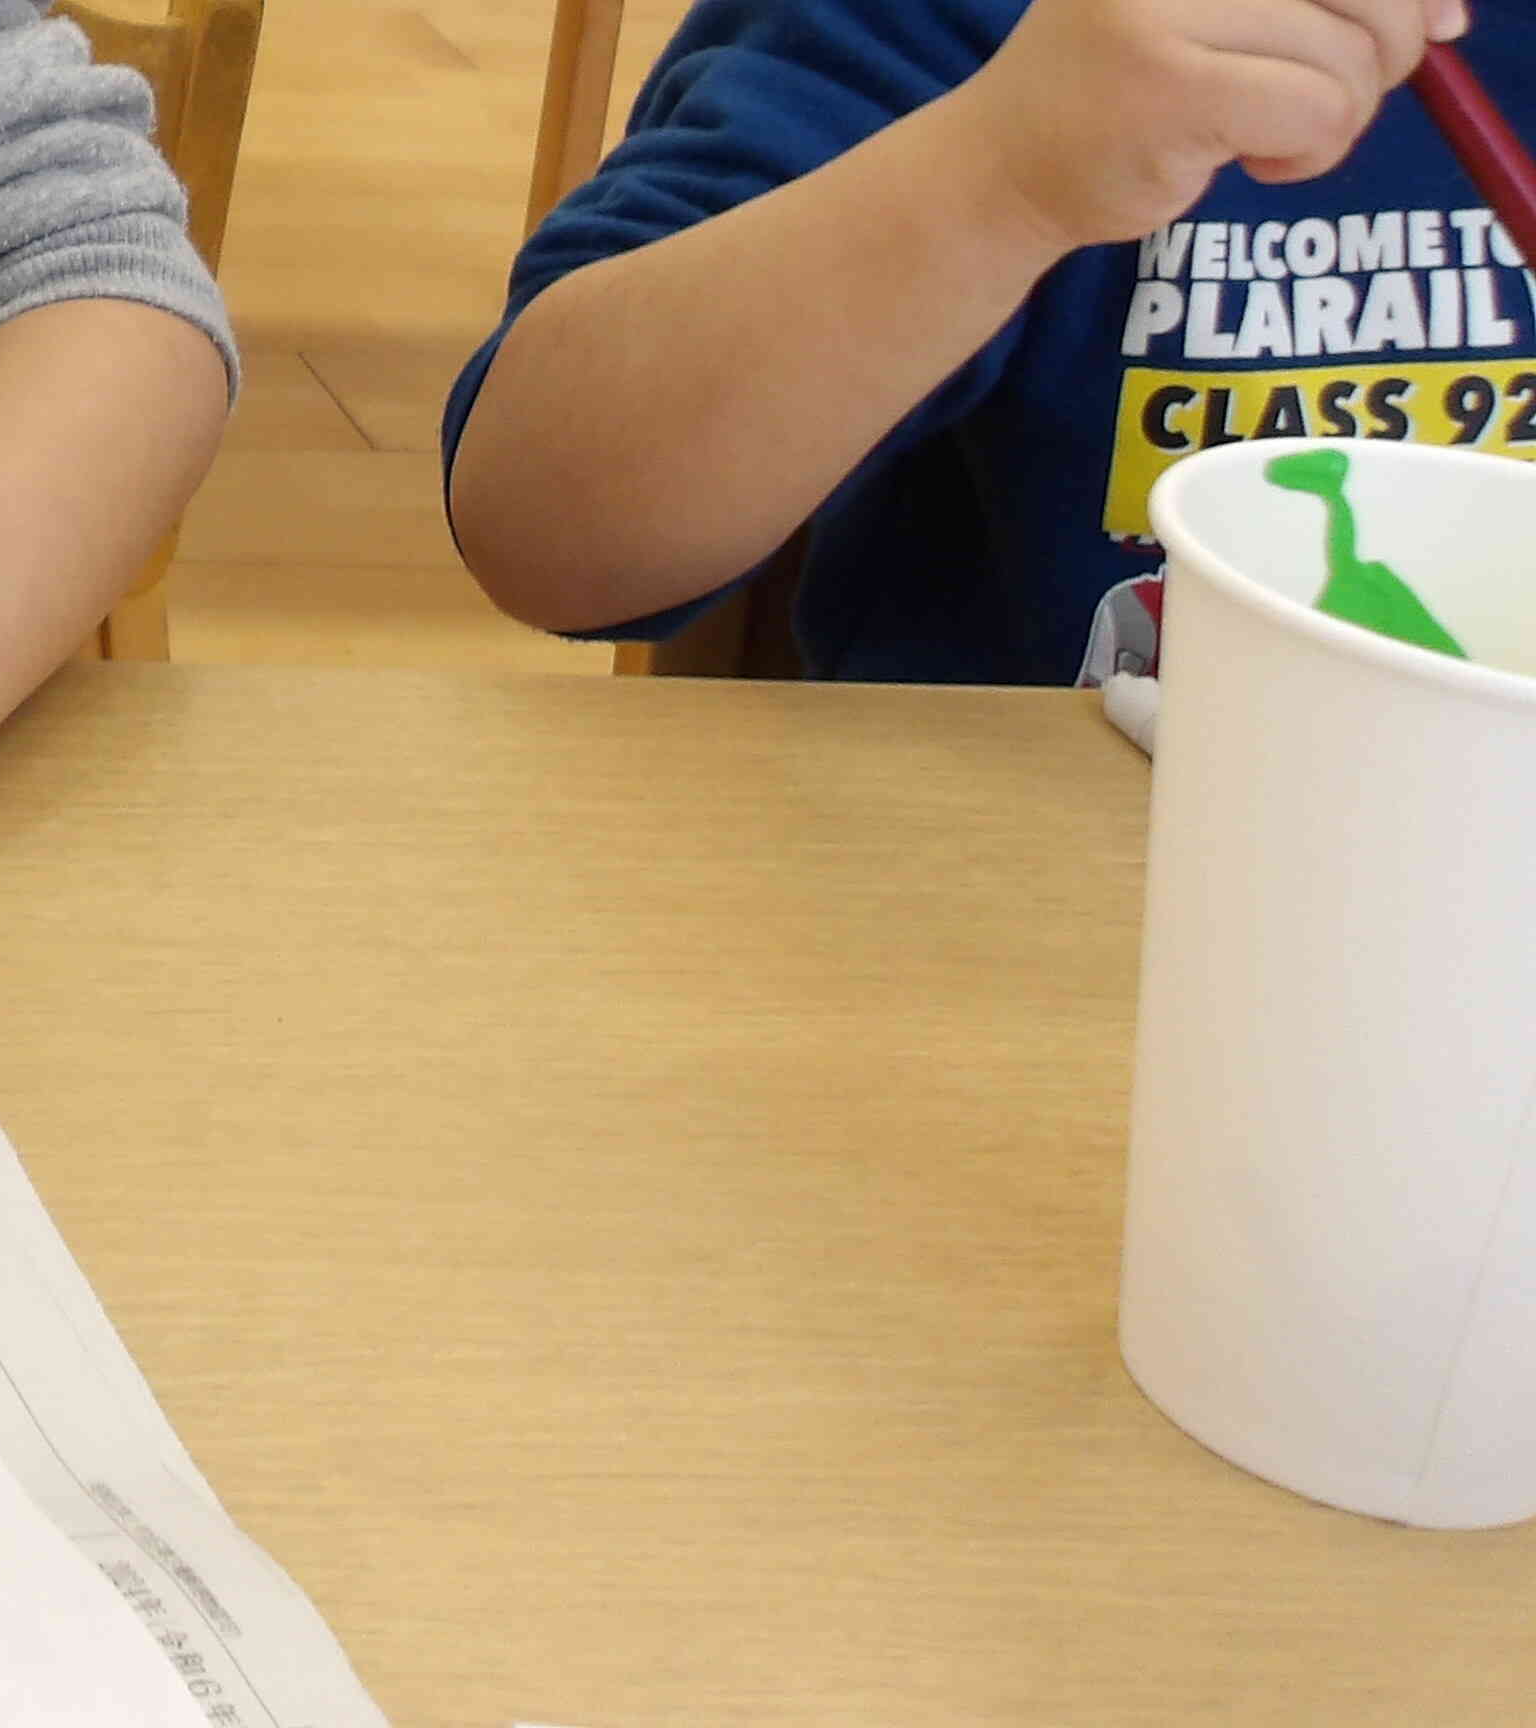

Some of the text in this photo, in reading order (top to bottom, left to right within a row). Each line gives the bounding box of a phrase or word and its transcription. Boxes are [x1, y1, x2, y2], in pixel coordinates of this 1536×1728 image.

[1136, 210, 1442, 280] WELCOME
[1121, 268, 1516, 359] PLARAIL
[1141, 377, 1413, 450] CLASS
